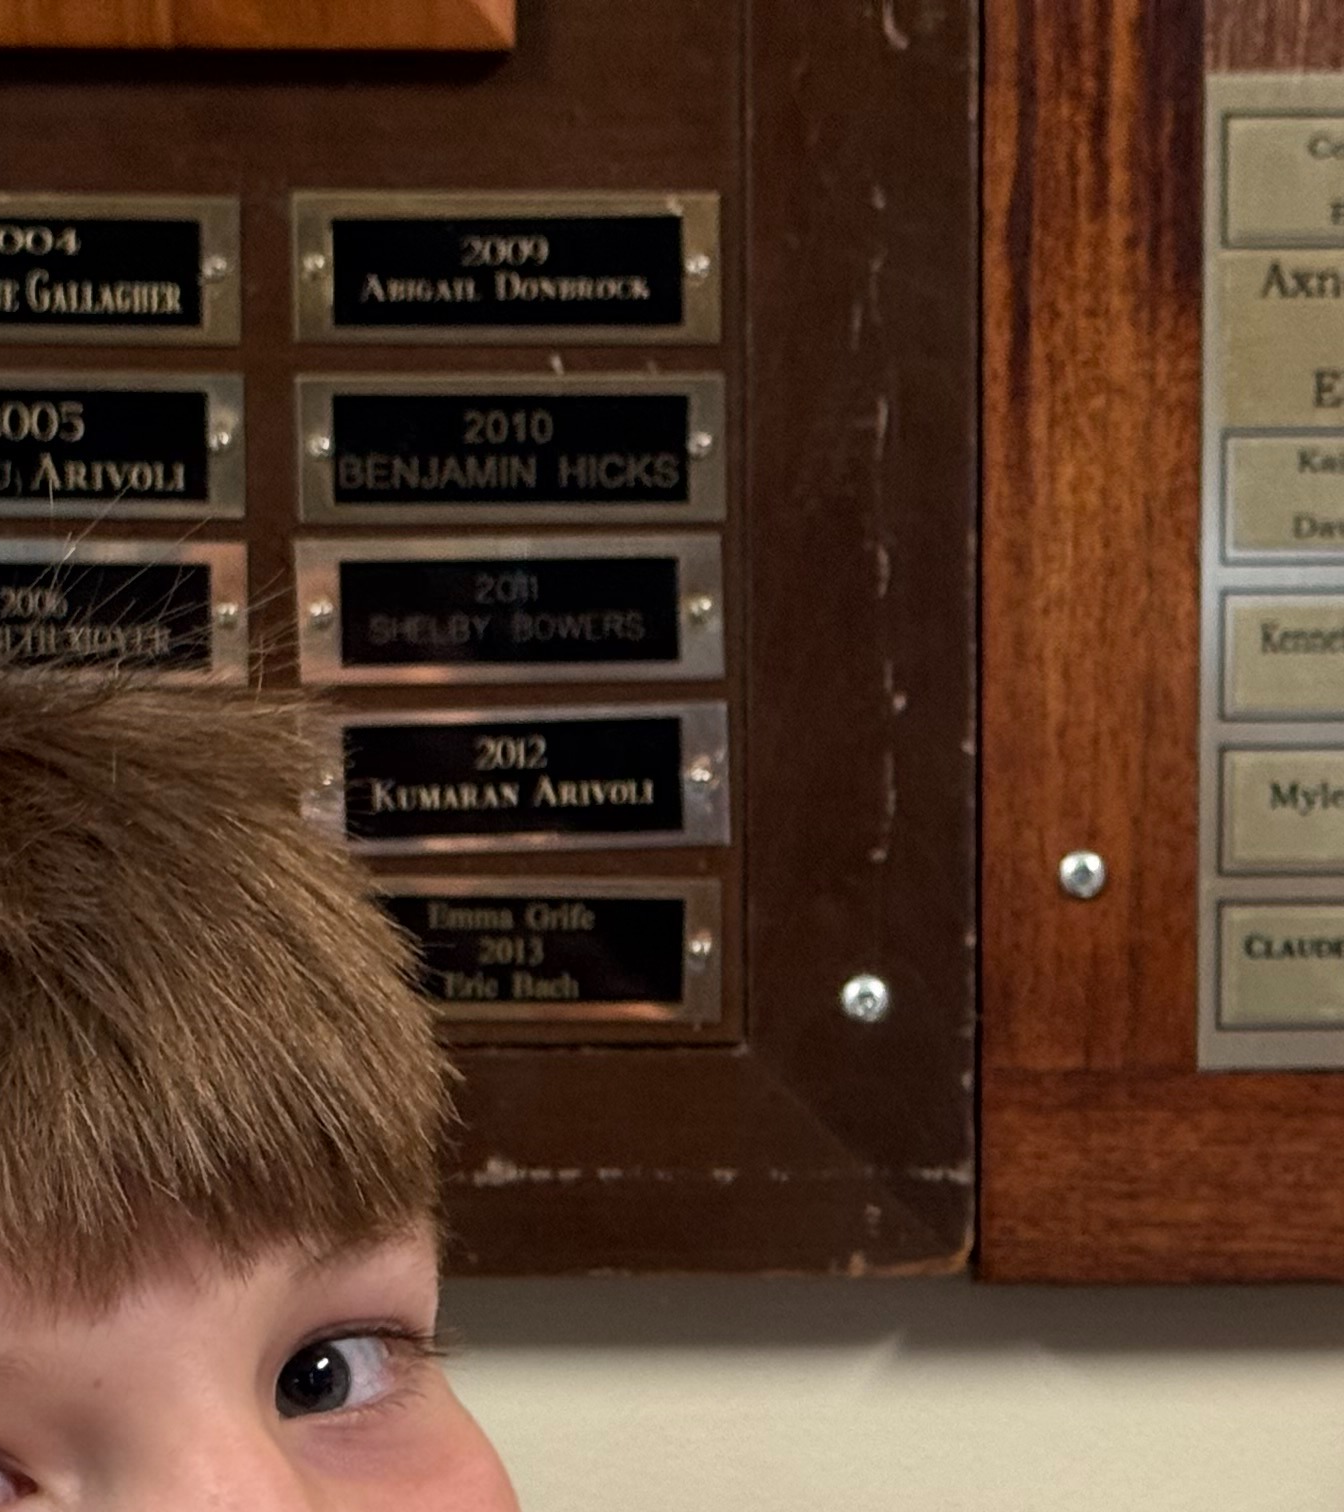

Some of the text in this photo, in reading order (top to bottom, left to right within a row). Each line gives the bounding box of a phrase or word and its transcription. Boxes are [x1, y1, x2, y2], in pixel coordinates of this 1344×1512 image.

[460, 233, 551, 267] 2009
[462, 409, 555, 446] 2010
[337, 453, 682, 493] BENJAMIN HICKS
[474, 571, 540, 605] 2011
[367, 609, 648, 646] SHELBY BOWERS
[474, 735, 549, 771] 2012
[427, 902, 515, 932] Emma
[477, 936, 545, 967] 2013
[443, 970, 580, 1001] Eric Bach
